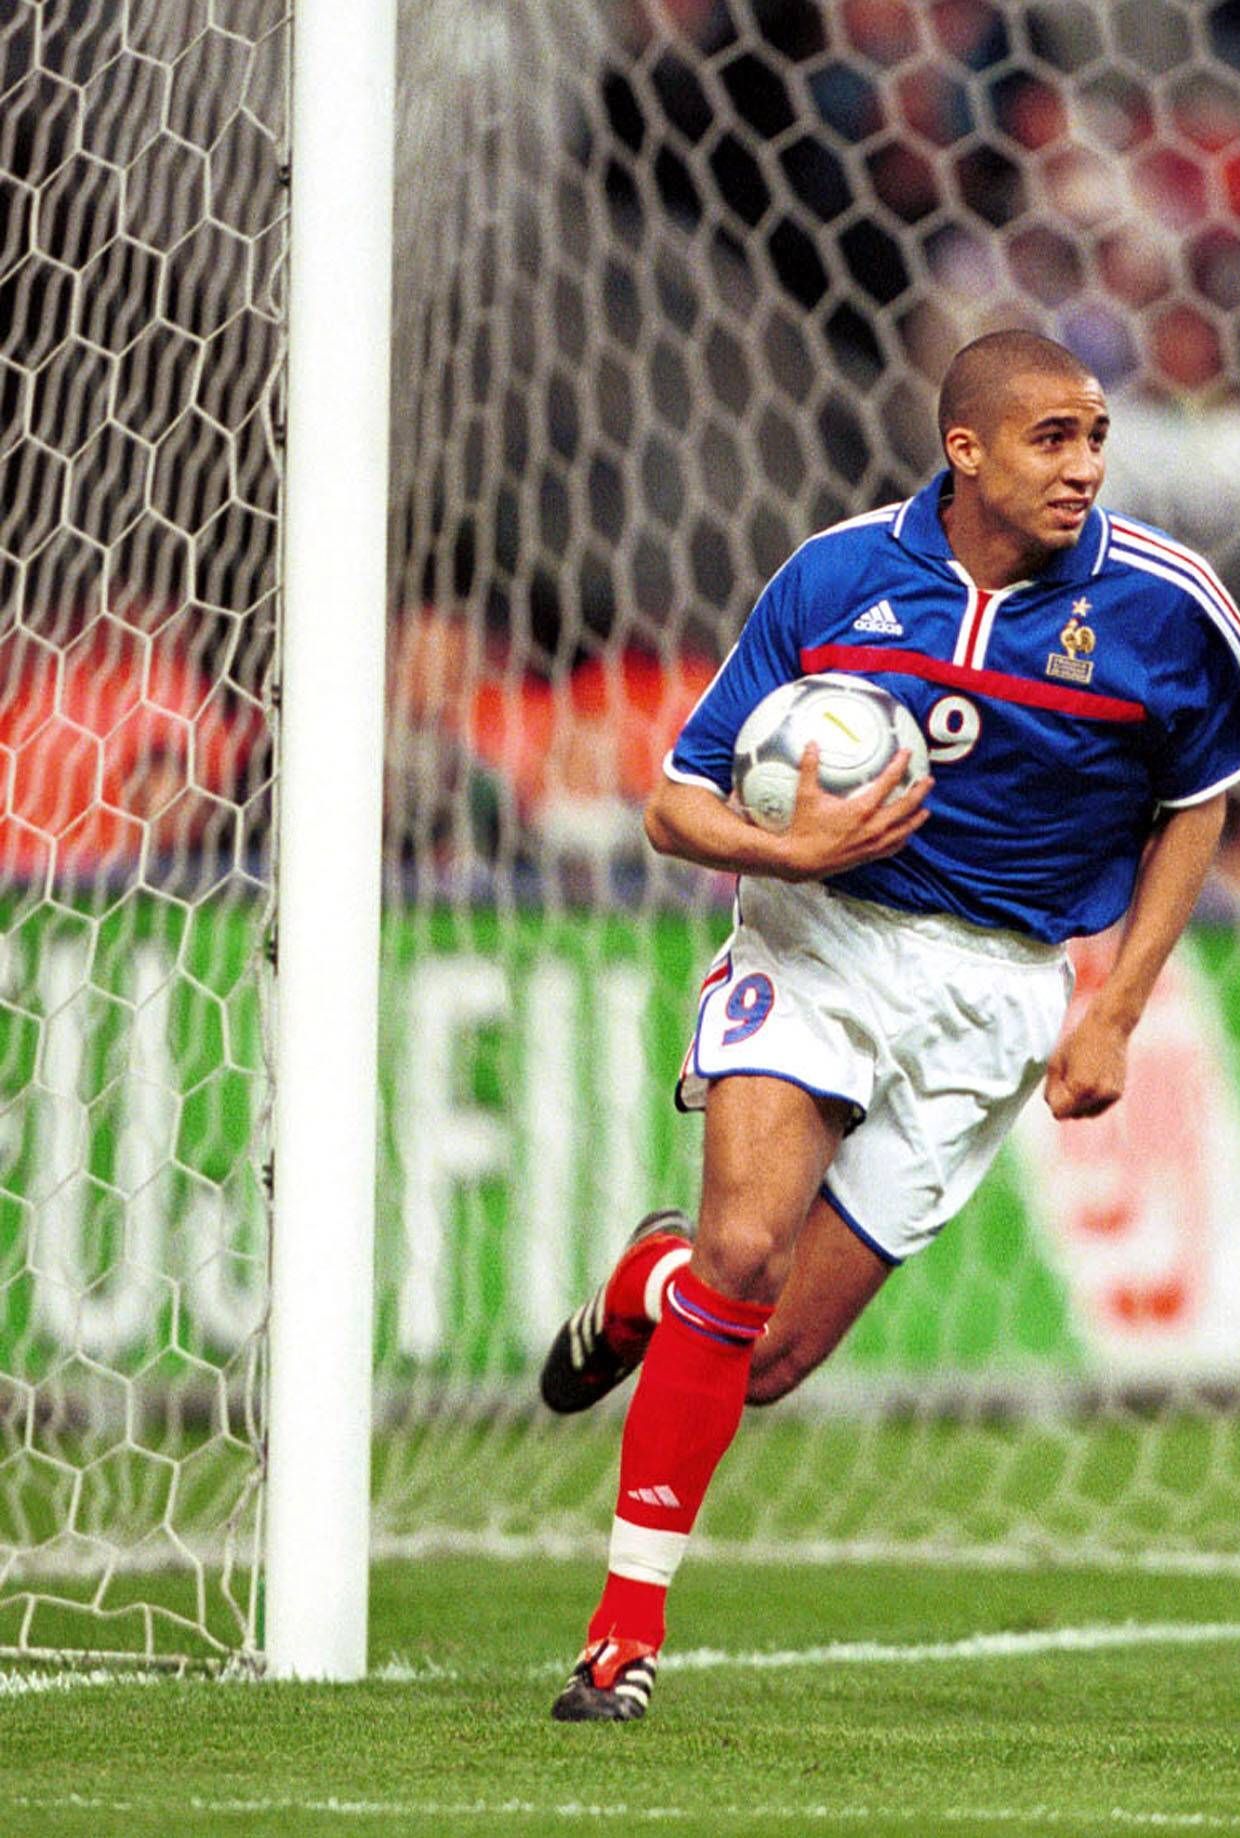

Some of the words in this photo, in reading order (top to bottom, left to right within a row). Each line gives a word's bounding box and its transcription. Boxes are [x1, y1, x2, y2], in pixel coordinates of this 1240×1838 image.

[853, 619, 904, 636] adidas
[928, 694, 981, 763] 9
[722, 972, 775, 1046] 9
